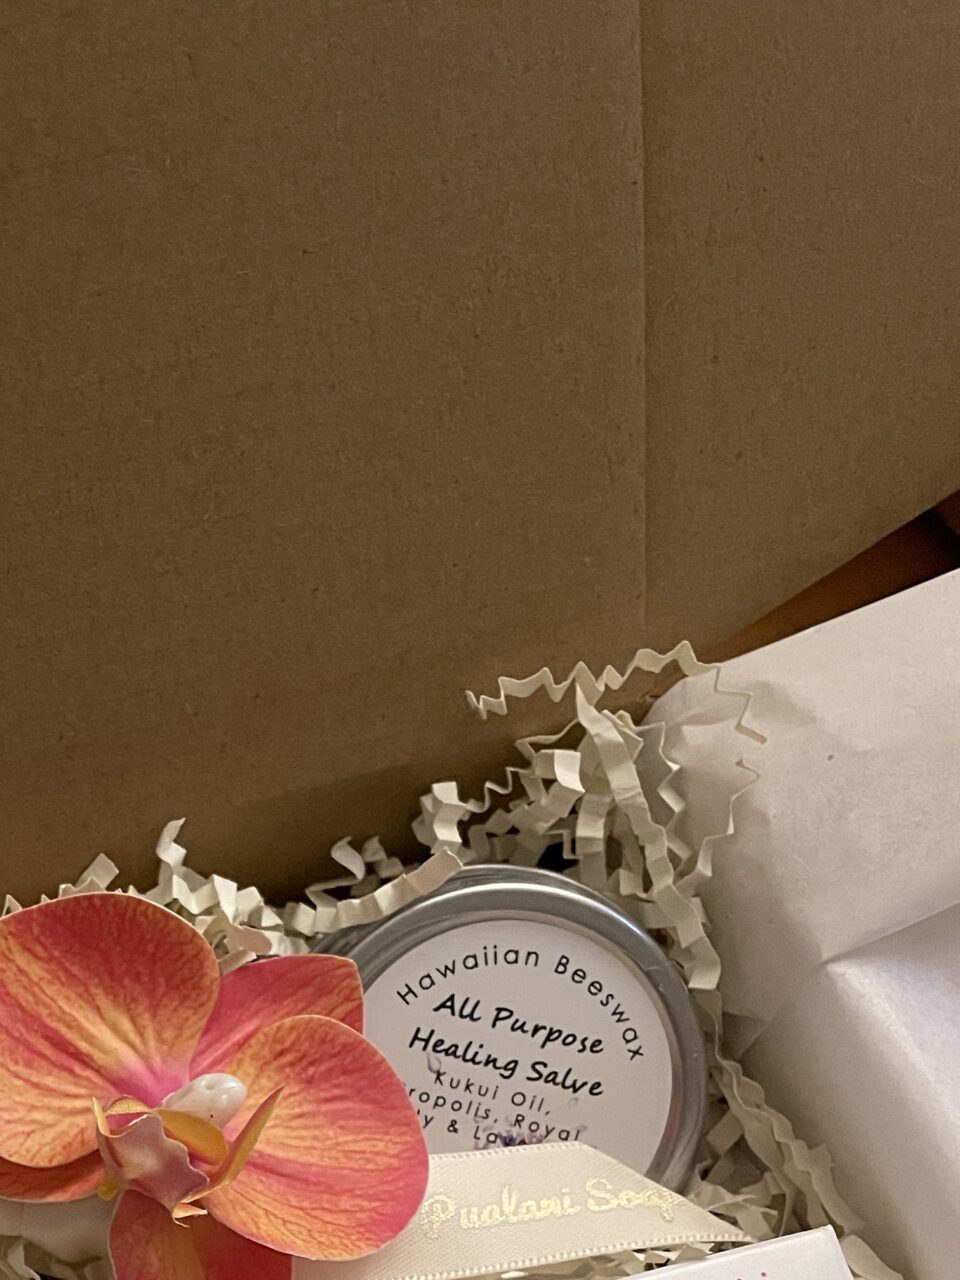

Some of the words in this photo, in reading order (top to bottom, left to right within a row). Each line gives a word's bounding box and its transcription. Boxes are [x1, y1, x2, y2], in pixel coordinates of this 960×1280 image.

[397, 944, 540, 1006] Hawaiian
[554, 954, 645, 1062] Beeswax
[433, 993, 483, 1024] All
[491, 1008, 605, 1056] Purpose
[408, 1027, 520, 1080] Healing
[526, 1060, 604, 1097] Salve
[409, 1088, 498, 1124] ropolis,
[513, 1113, 581, 1142] Royal
[434, 1070, 499, 1100] Kukui
[511, 1092, 551, 1117] Oil,
[447, 1119, 459, 1134] &
[424, 1186, 581, 1239] Pualani
